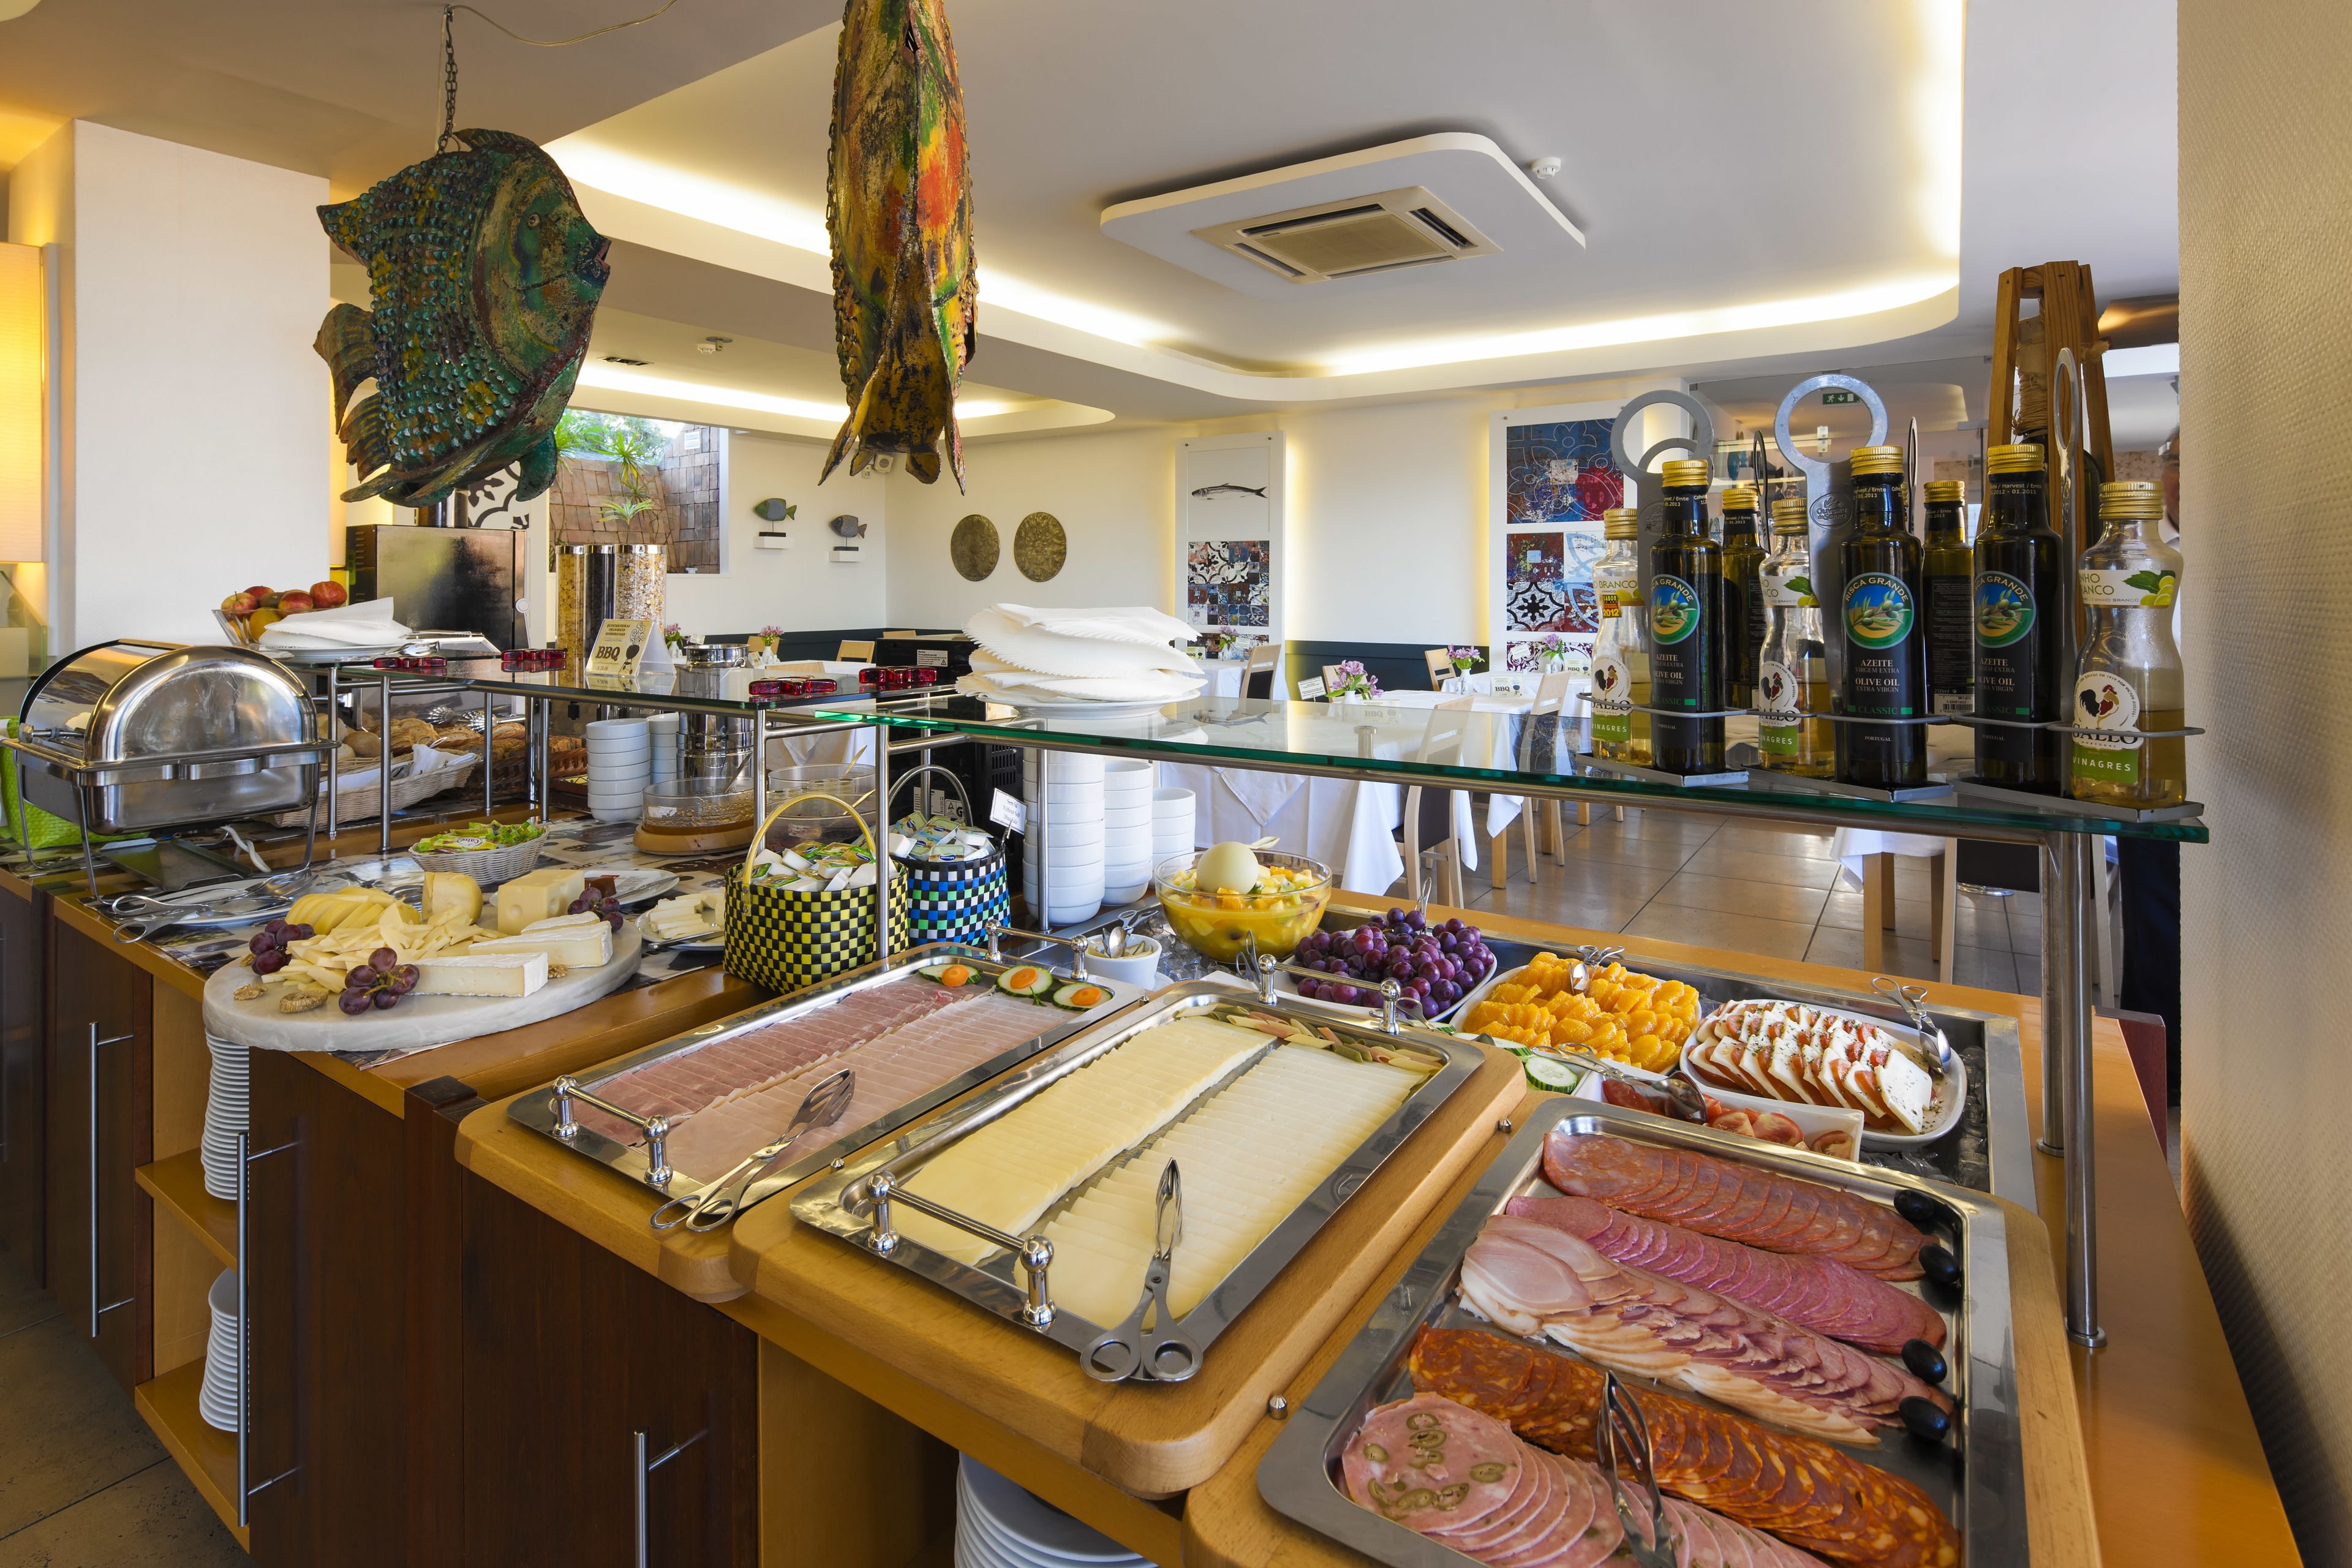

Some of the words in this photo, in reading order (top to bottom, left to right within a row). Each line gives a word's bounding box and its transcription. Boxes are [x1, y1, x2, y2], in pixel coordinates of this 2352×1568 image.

[1599, 580, 1638, 589] BRANCO
[1986, 576, 2029, 601] GRANDE
[1659, 579, 1694, 603] GRANDE
[1845, 579, 1866, 601] RISCA
[1868, 578, 1909, 602] GRANDE
[1603, 608, 1619, 617] 2012
[595, 646, 620, 662] BBQ
[1860, 659, 1894, 668] AZEITE
[1980, 658, 2008, 666] AZEITE
[1855, 677, 1882, 686] OLIVE
[1883, 678, 1900, 687] OIL
[1997, 677, 2015, 686] OIL
[1858, 706, 1898, 715] CLASSIC
[2073, 756, 2131, 772] VINAGRES
